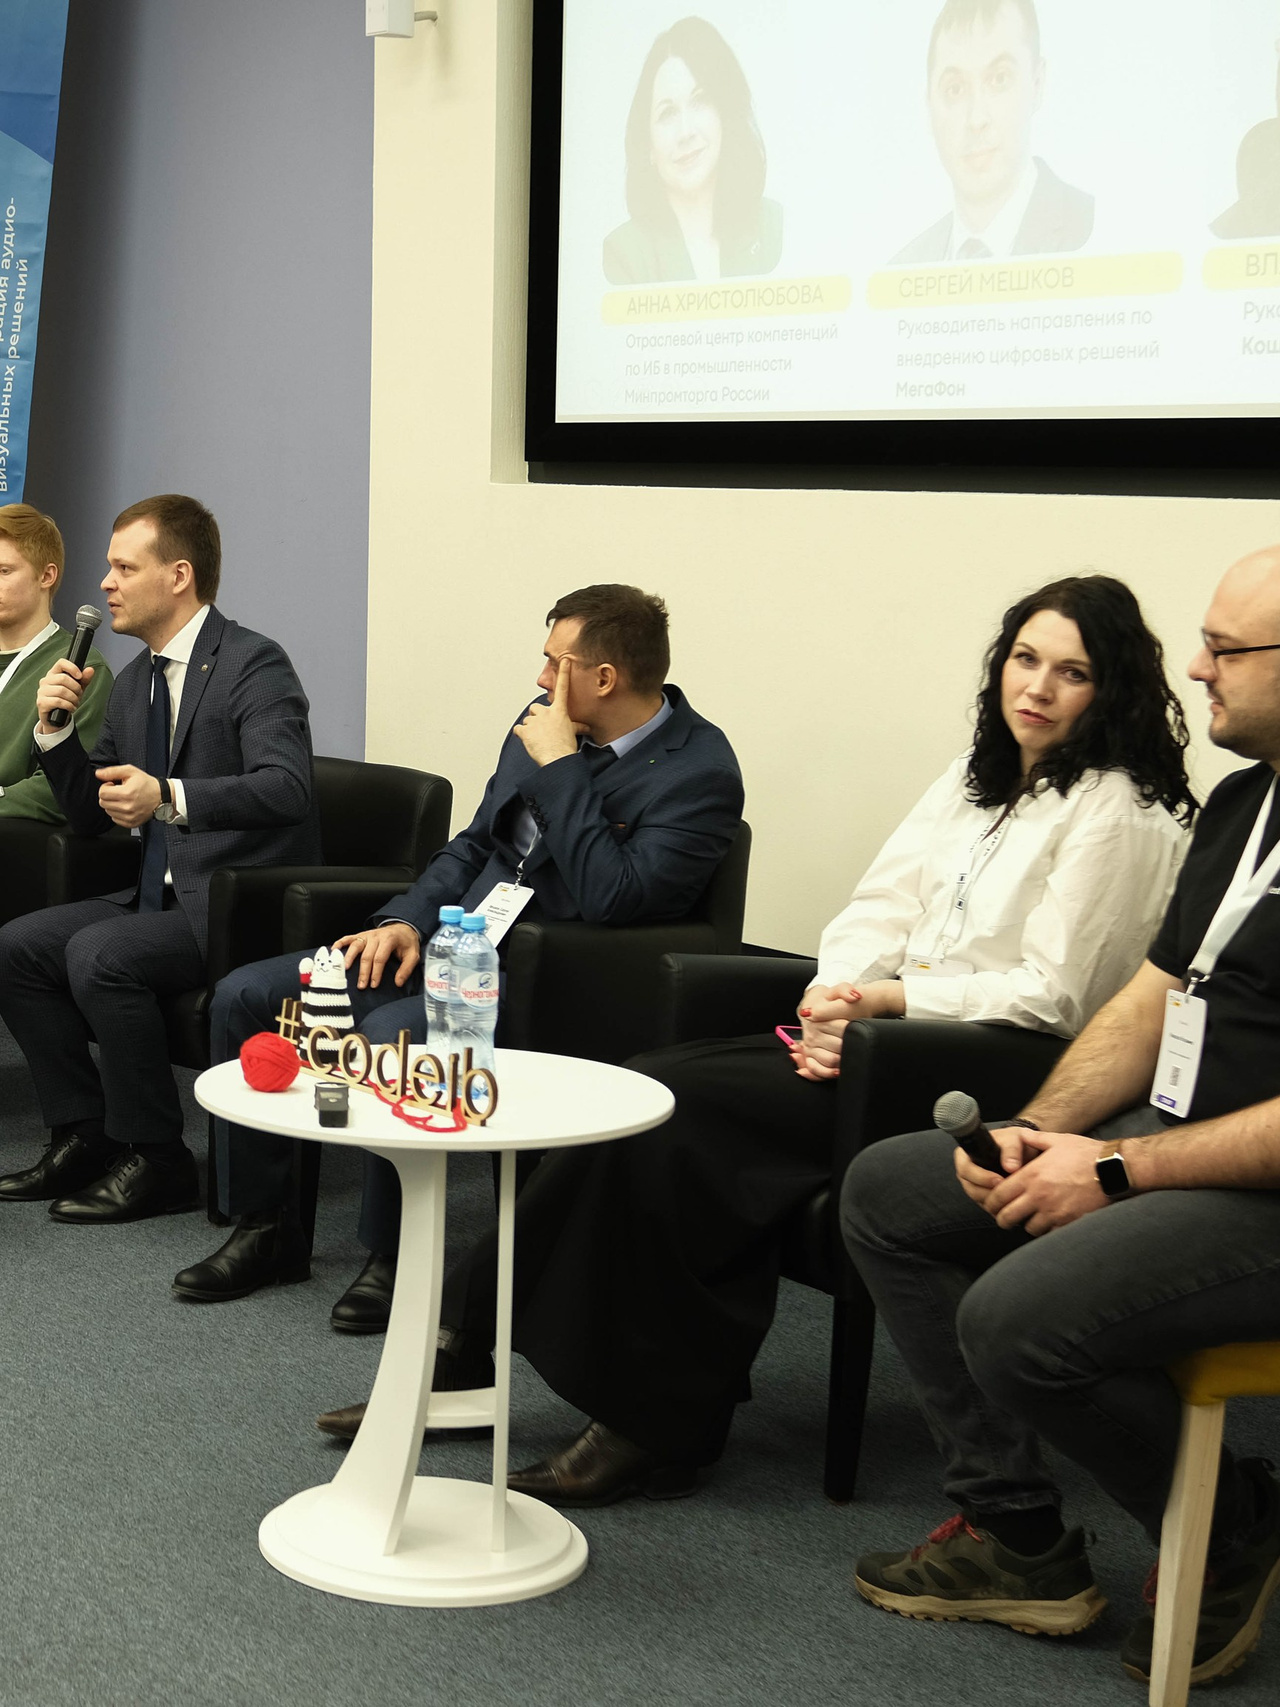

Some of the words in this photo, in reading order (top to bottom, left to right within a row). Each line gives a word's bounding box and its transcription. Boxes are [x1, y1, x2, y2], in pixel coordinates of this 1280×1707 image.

[1, 197, 17, 271] аудио-
[1245, 252, 1280, 277] ВЛ
[898, 268, 973, 298] СЕРГЕЙ
[979, 266, 1075, 293] МЕШКОВ
[7, 258, 28, 359] решений
[626, 295, 672, 316] АННА
[675, 284, 825, 313] ХРИСТОЛЮБОВА
[625, 331, 703, 351] Отраслевой
[706, 331, 745, 347] центр
[748, 323, 839, 344] компетенций
[897, 315, 1006, 339] Руководитель
[1011, 310, 1126, 333] направления
[1131, 309, 1153, 326] по
[624, 363, 641, 377] по
[644, 359, 660, 376] ИБ
[664, 364, 670, 376] в
[673, 358, 793, 378] промышленности
[896, 349, 984, 369] внедрению
[989, 345, 1074, 366] цифровых
[1078, 340, 1160, 363] решений
[624, 388, 718, 406] Минпромторга
[721, 386, 771, 402] России
[895, 380, 966, 398] МегаФон
